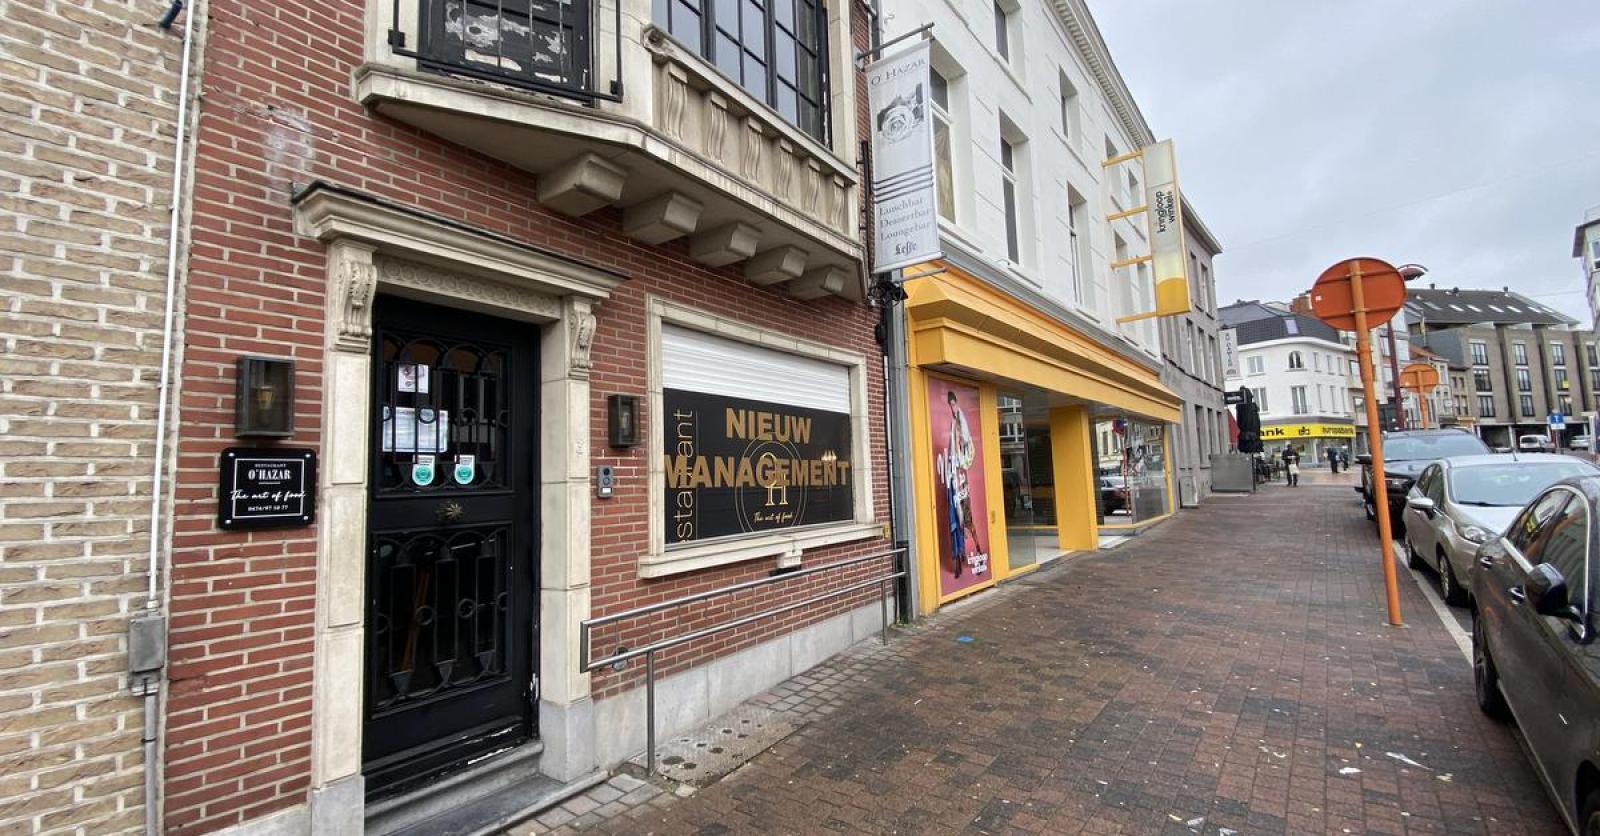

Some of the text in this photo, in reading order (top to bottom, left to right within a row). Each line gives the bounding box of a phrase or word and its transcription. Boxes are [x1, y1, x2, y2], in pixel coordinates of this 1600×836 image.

[1155, 190, 1166, 234] kringloop
[725, 407, 812, 444] NIEUW
[1260, 427, 1285, 437] ank
[247, 469, 292, 481] O'HAZAR
[664, 453, 850, 489] MANAGEMENT
[230, 488, 249, 501] The
[251, 491, 270, 499] art
[271, 491, 282, 502] of
